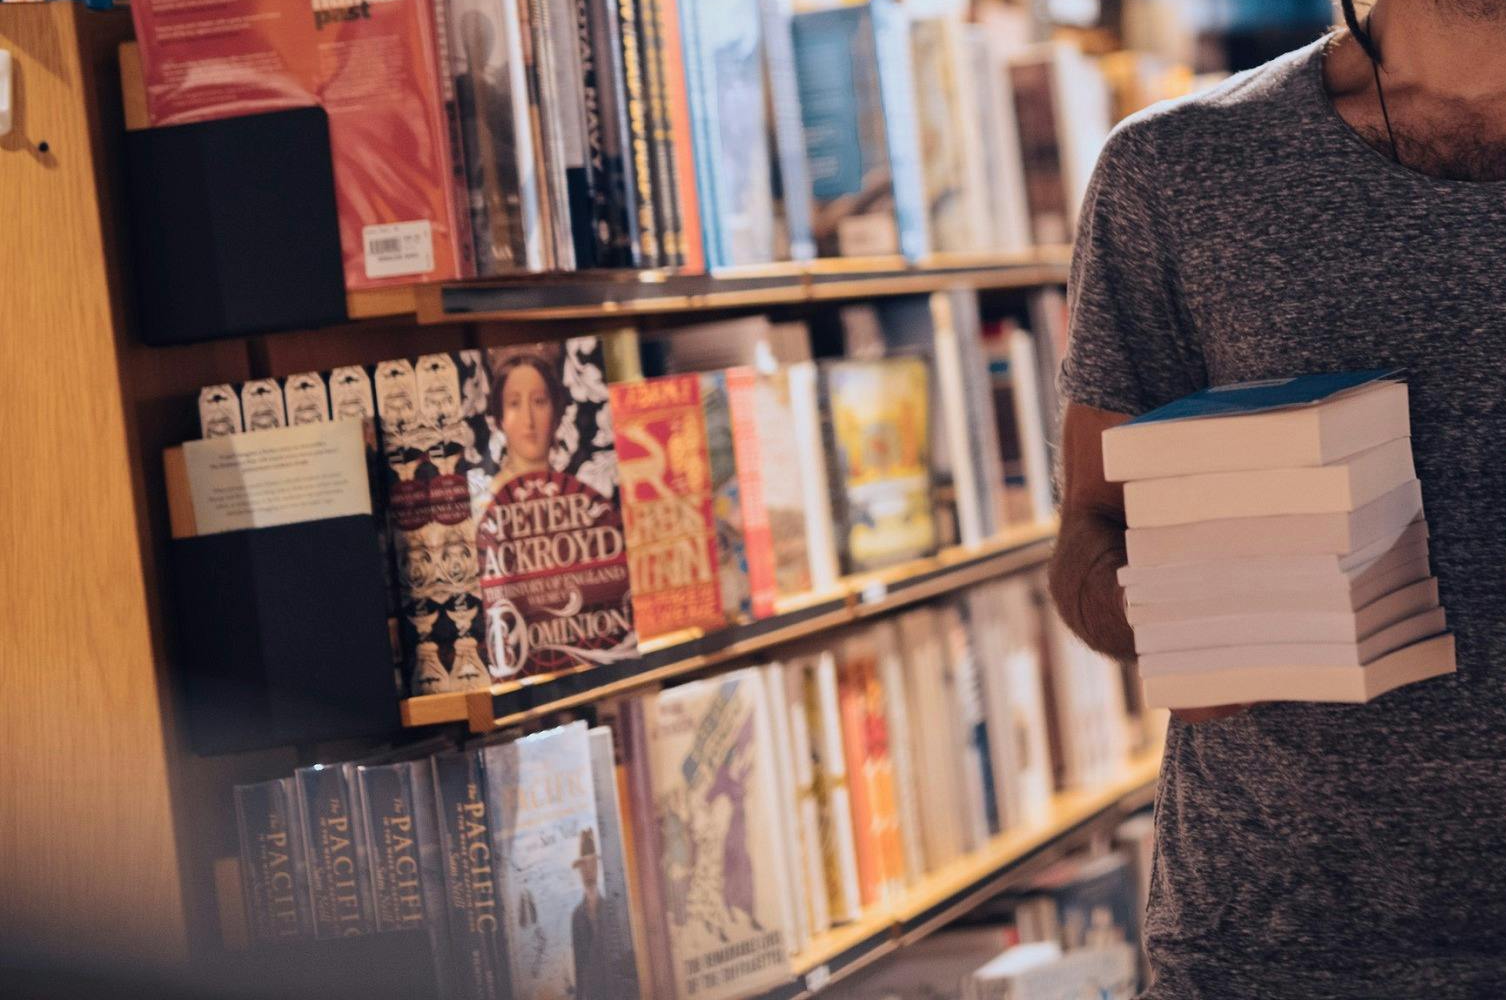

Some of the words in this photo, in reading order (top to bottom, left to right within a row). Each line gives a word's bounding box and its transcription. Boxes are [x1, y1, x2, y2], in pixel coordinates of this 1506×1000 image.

[314, 0, 371, 30] past
[493, 493, 594, 540] PETER
[484, 525, 623, 581] ACKROYD
[564, 565, 627, 588] ENGLAND
[467, 783, 478, 799] The
[267, 831, 298, 936] PACIFI
[391, 815, 423, 921] PACIFI
[463, 801, 498, 934] PACIFIC
[451, 876, 465, 908] Neill
